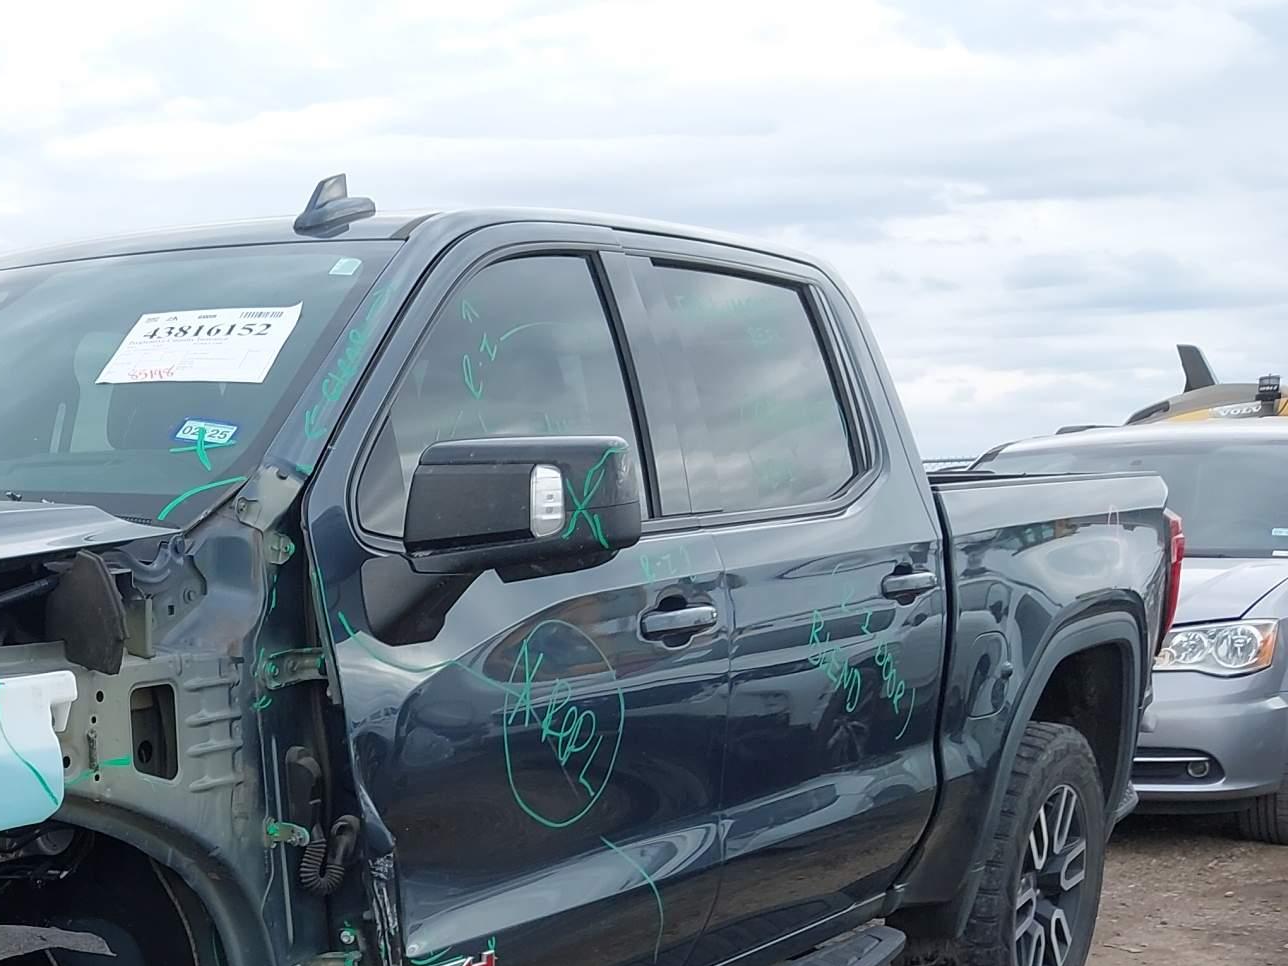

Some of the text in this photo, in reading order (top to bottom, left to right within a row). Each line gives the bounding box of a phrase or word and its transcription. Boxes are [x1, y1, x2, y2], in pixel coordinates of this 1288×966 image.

[144, 323, 272, 340] 43816152
[1219, 405, 1262, 417] VOLV
[207, 428, 231, 440] 25
